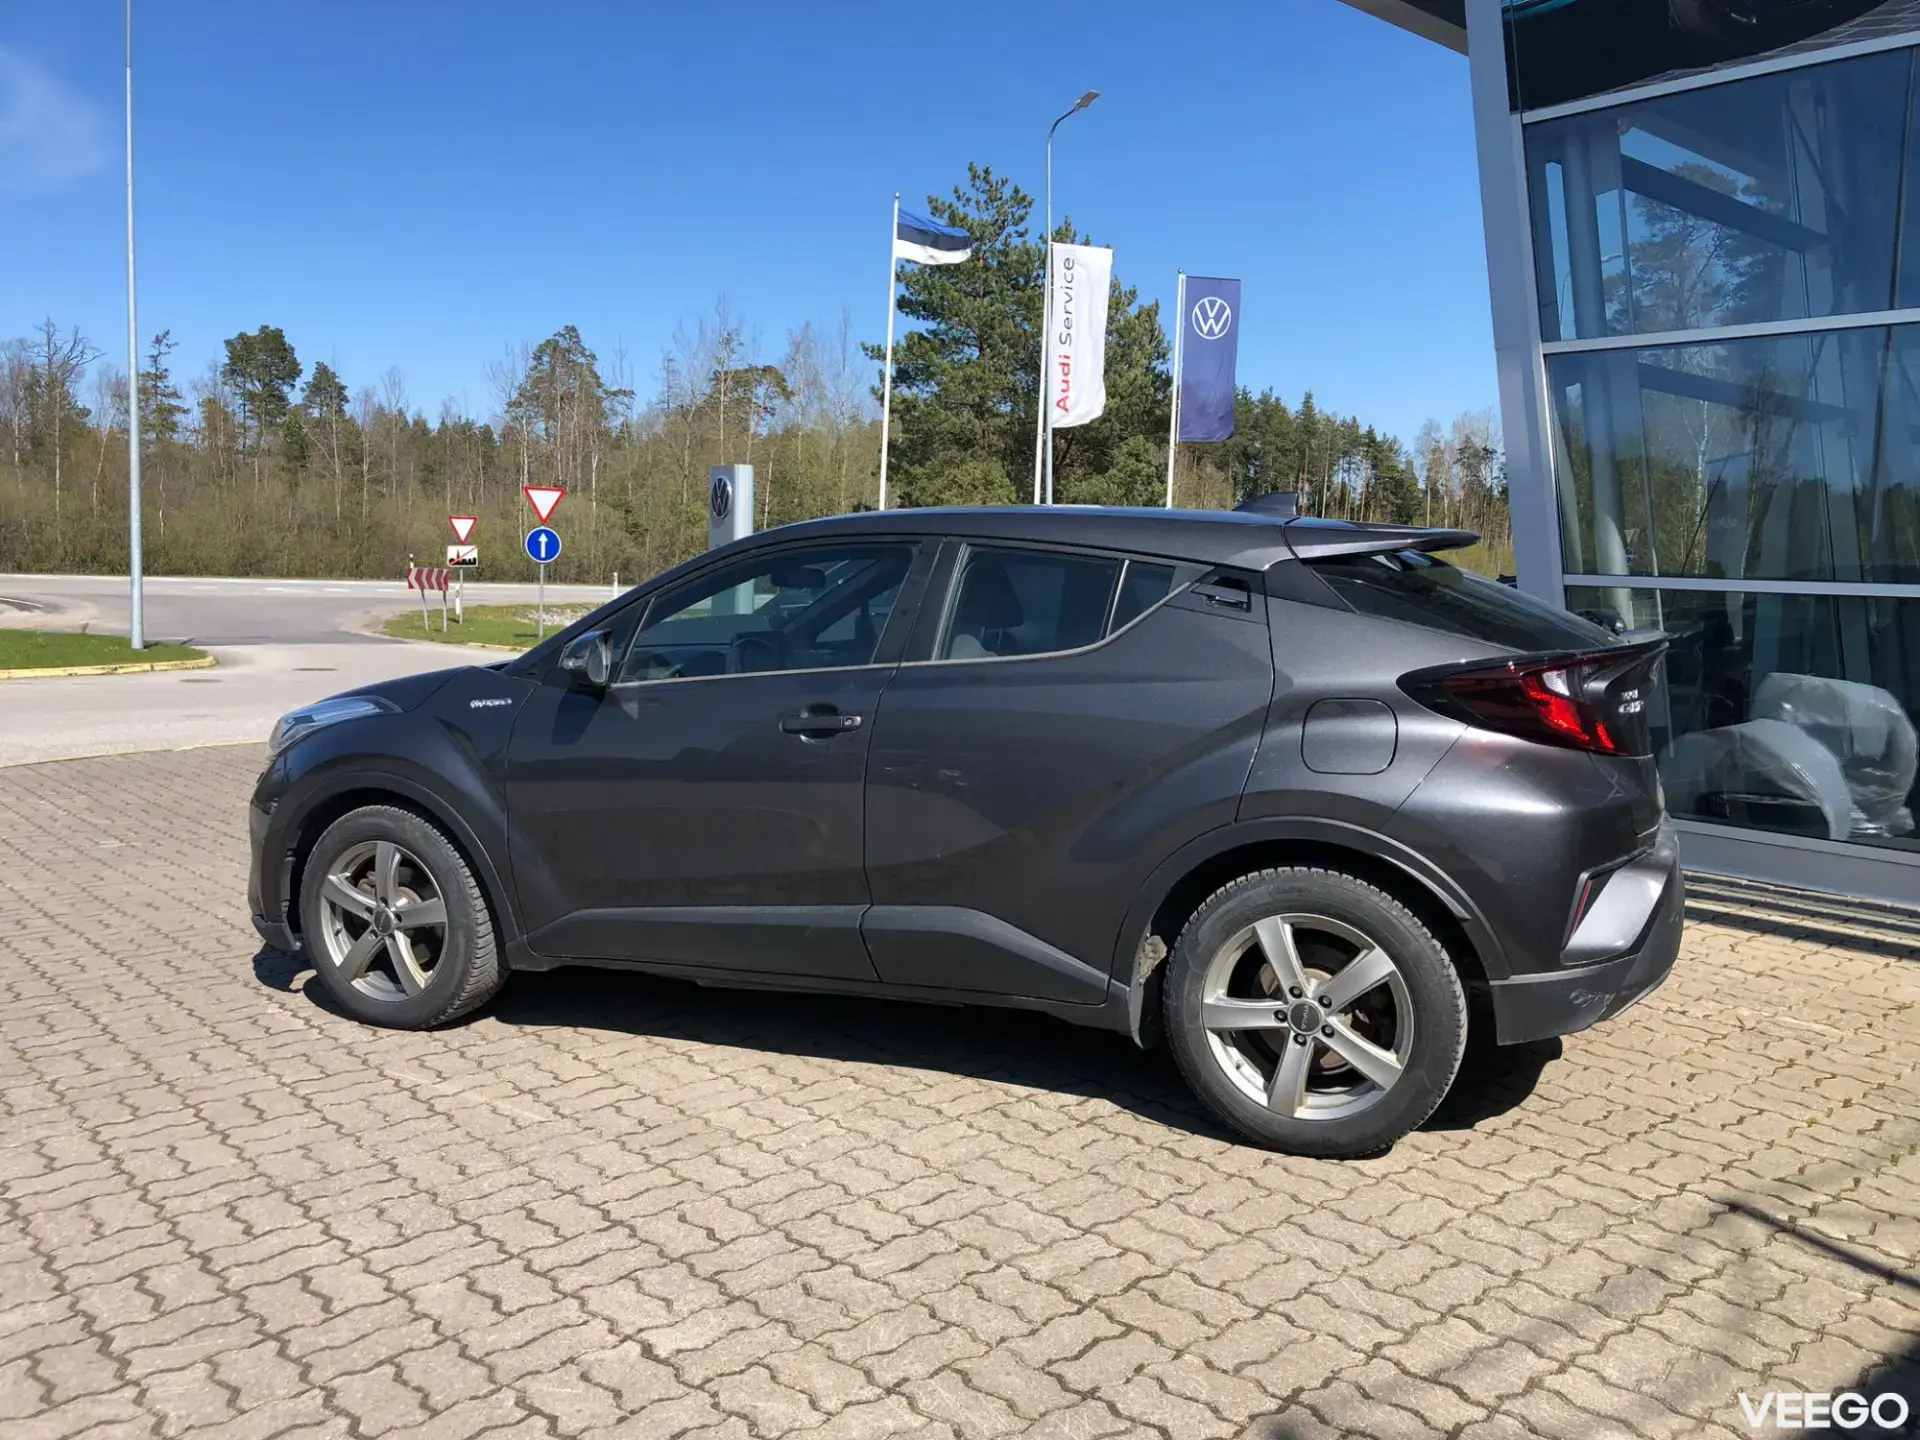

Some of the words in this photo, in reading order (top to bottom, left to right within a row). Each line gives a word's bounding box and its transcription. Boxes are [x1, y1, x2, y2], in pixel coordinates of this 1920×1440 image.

[1059, 257, 1075, 347] Service
[1193, 298, 1231, 337] VW
[1056, 354, 1071, 413] Audi
